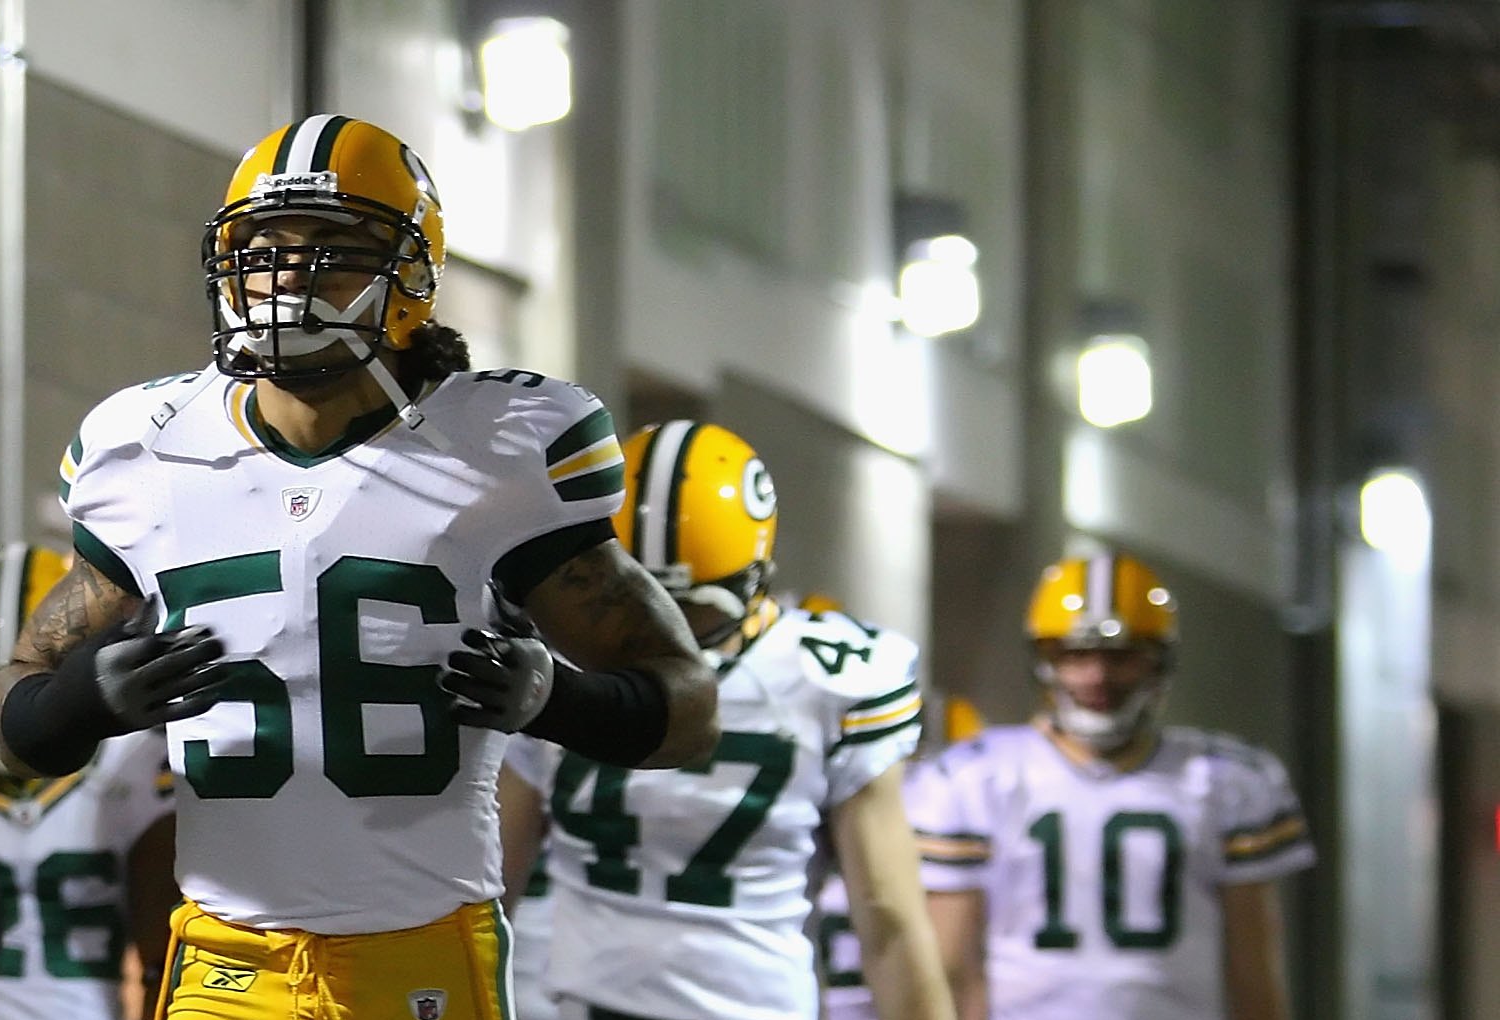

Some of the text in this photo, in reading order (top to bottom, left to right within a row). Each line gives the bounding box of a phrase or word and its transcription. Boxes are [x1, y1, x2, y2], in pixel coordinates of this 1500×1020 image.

[155, 550, 460, 799] 56
[551, 731, 796, 908] 47
[1027, 810, 1185, 951] 10
